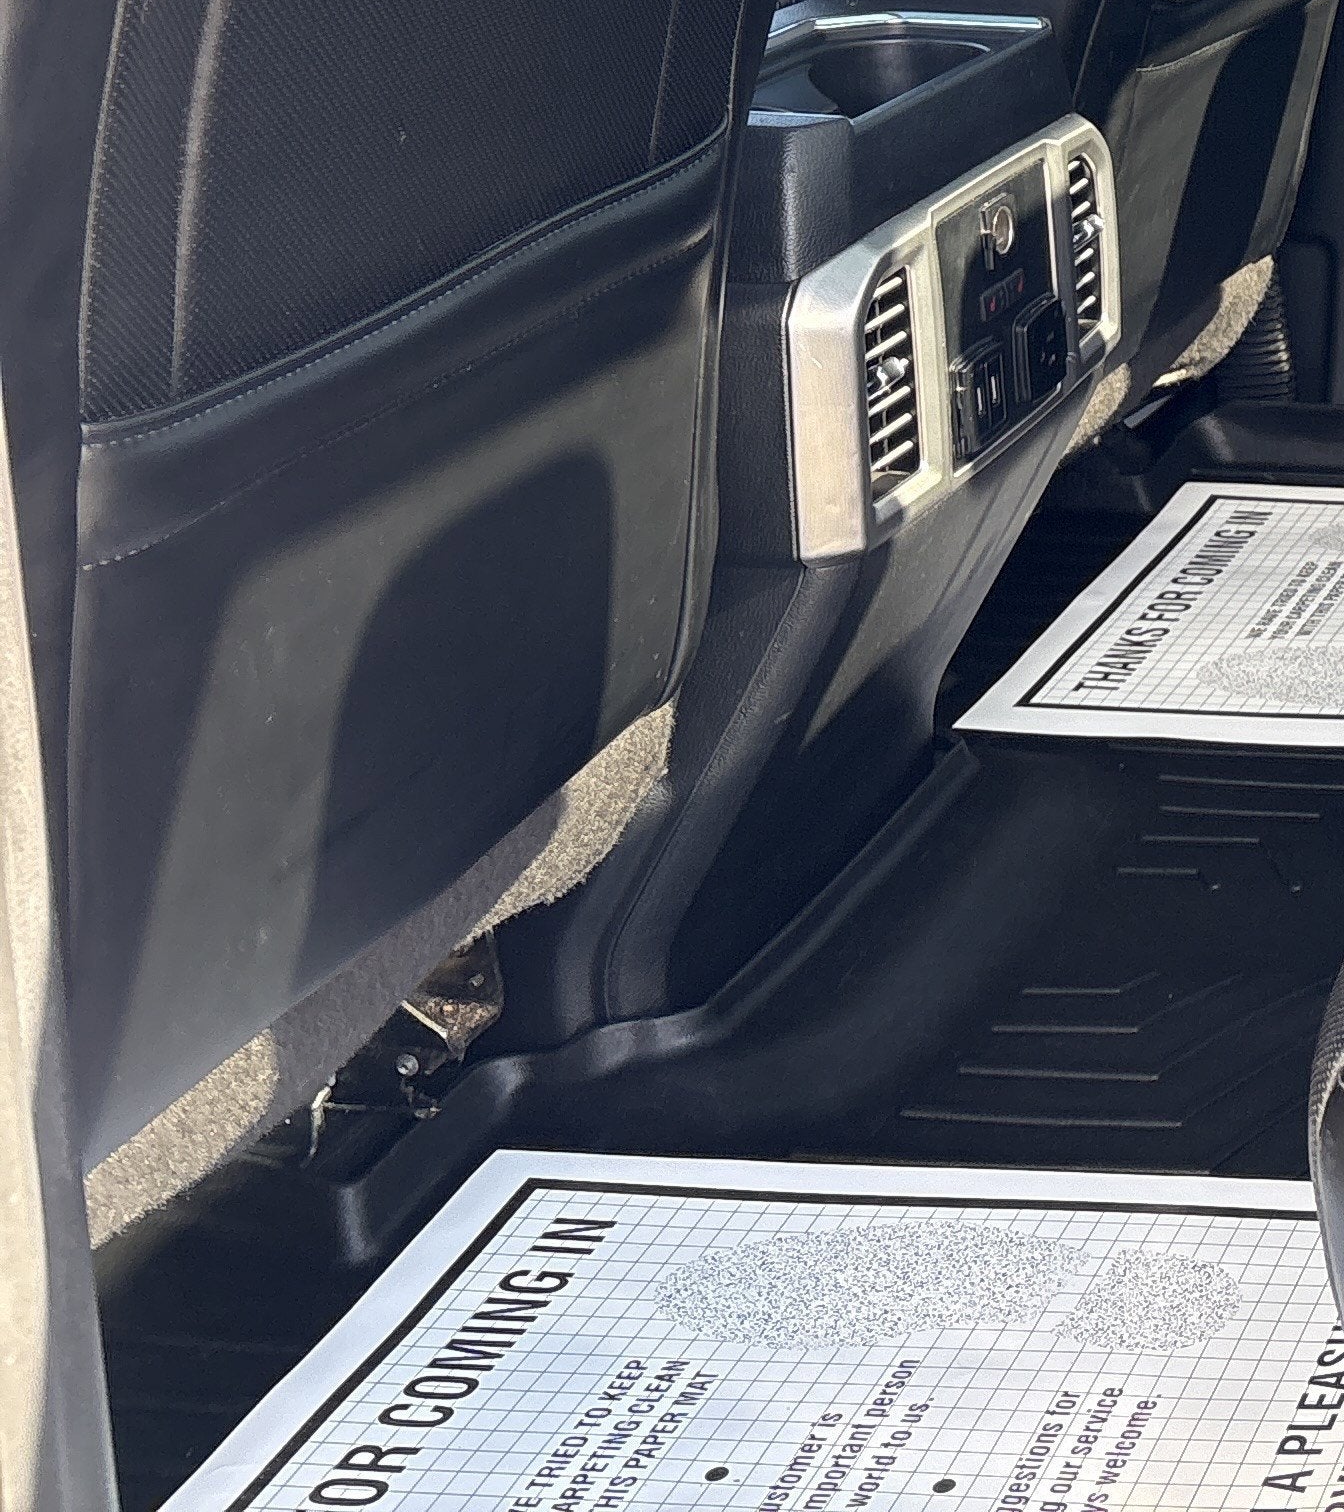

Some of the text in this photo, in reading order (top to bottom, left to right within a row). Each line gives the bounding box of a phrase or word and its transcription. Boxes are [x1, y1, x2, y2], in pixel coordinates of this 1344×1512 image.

[1071, 510, 1273, 691] THANKS FOR COMING IN
[296, 1217, 617, 1512] OR COMING IN
[864, 1359, 920, 1418] person
[1044, 1391, 1080, 1416] for
[525, 1436, 588, 1490] TRIED
[573, 1407, 612, 1429] TO
[598, 1360, 648, 1401] KEEP
[551, 1360, 690, 1512] ARPETING CLEAN
[588, 1370, 719, 1512] HIS PAPER MAT
[811, 1412, 843, 1427] is
[845, 1397, 934, 1508] world to us.
[1050, 1461, 1082, 1494] our
[1071, 1387, 1123, 1455] service
[1095, 1394, 1162, 1485] welcome.
[1262, 1469, 1314, 1493] A
